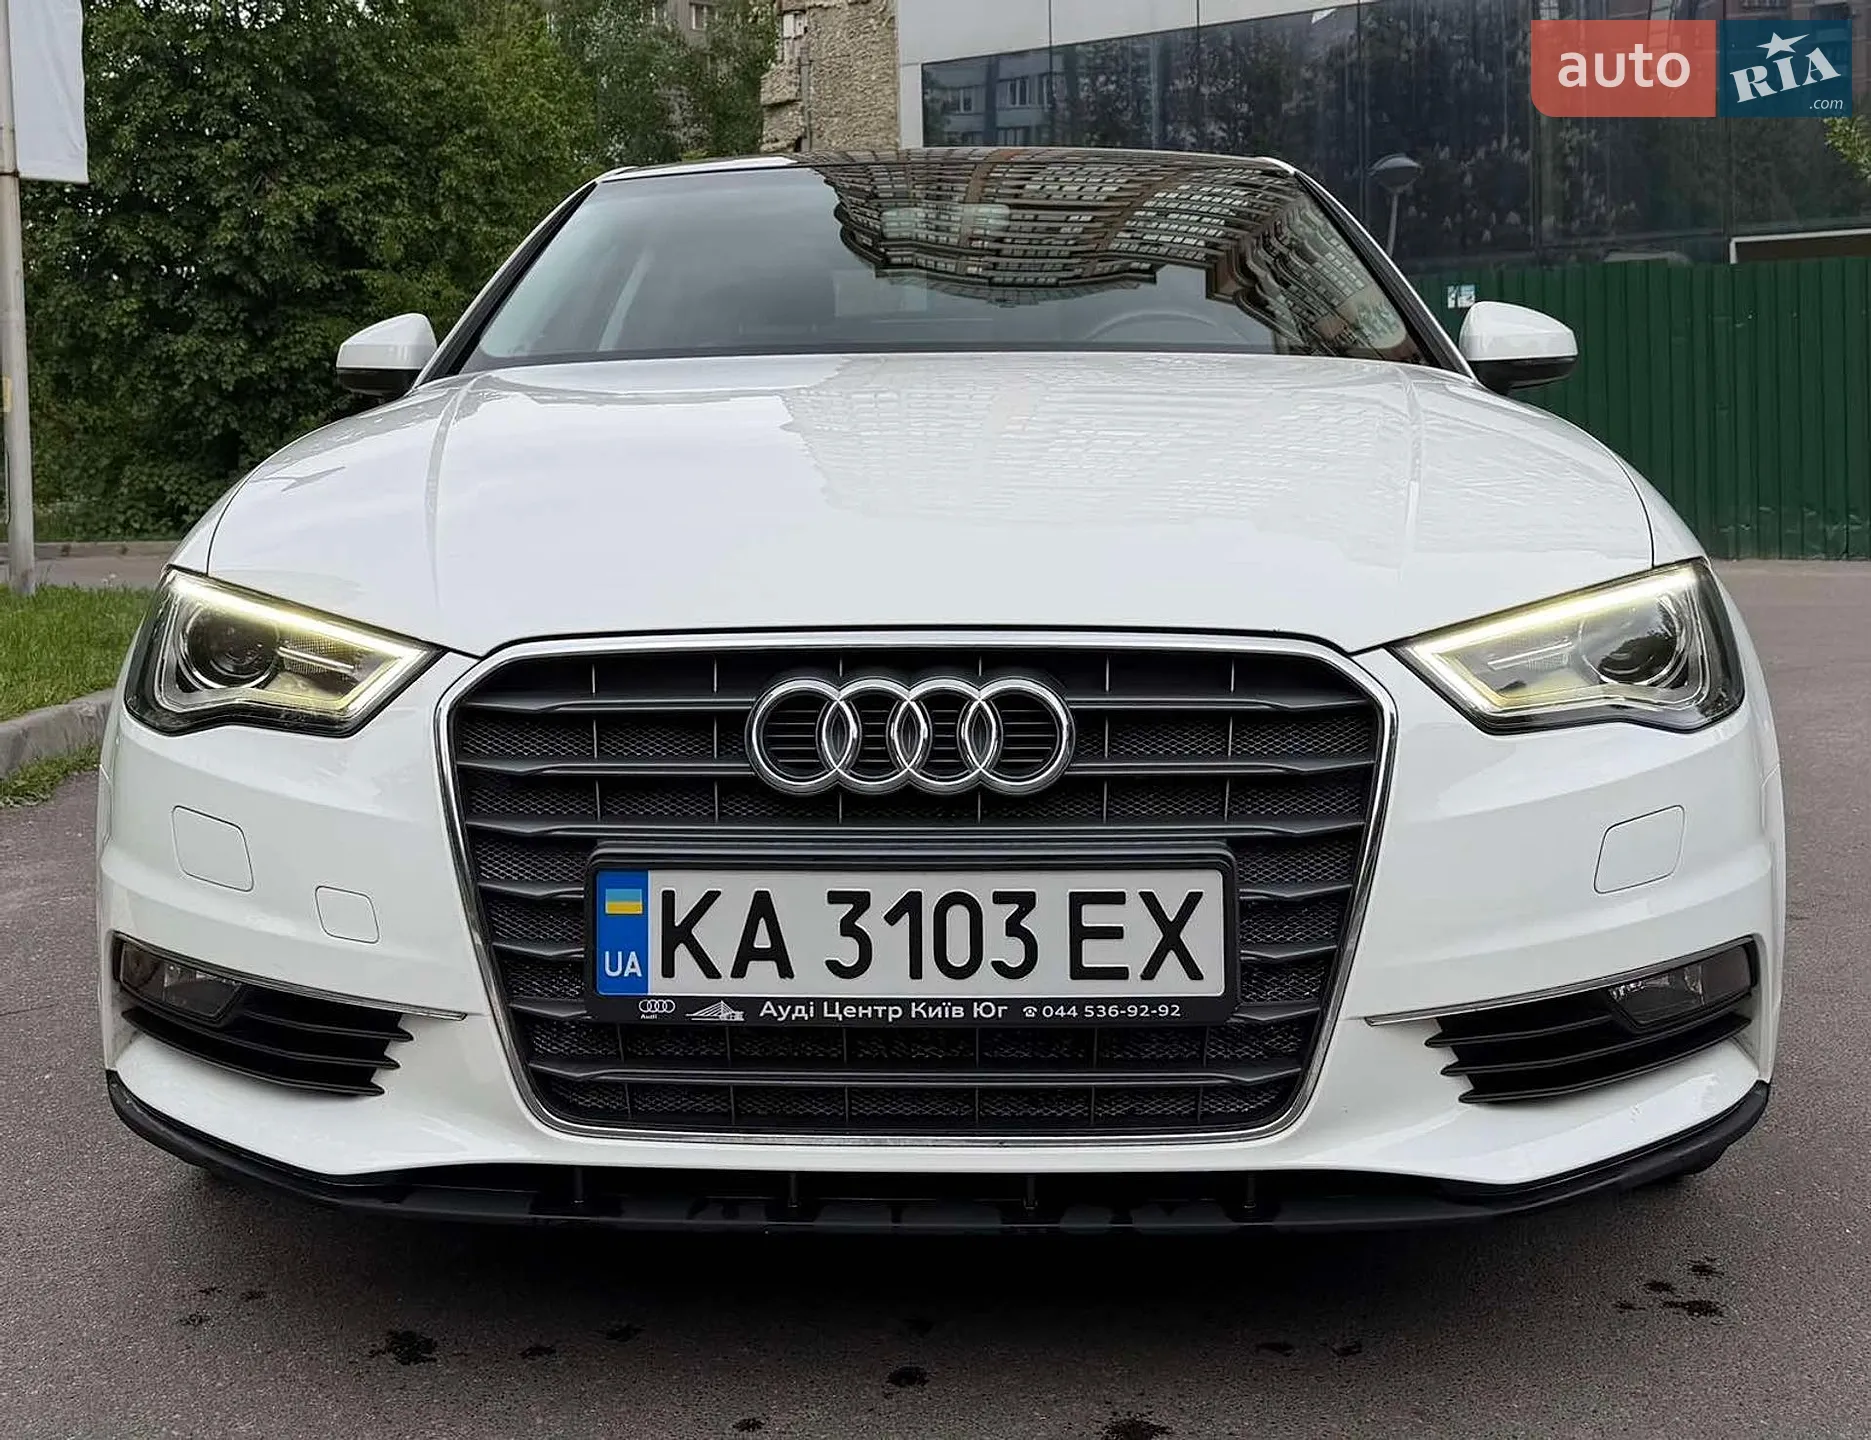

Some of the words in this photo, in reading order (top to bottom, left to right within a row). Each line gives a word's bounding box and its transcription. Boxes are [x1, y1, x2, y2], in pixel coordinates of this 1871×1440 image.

[661, 890, 794, 979] KA
[825, 890, 1038, 980] 3103
[1069, 890, 1204, 980] EX
[604, 950, 642, 977] UA
[759, 1001, 815, 1021] Ауді
[823, 1001, 902, 1020] Центр
[911, 1001, 965, 1019] Київ
[973, 1002, 1008, 1018] Юг
[1042, 1006, 1078, 1018] 044
[1084, 1004, 1181, 1018] 536-92-92
